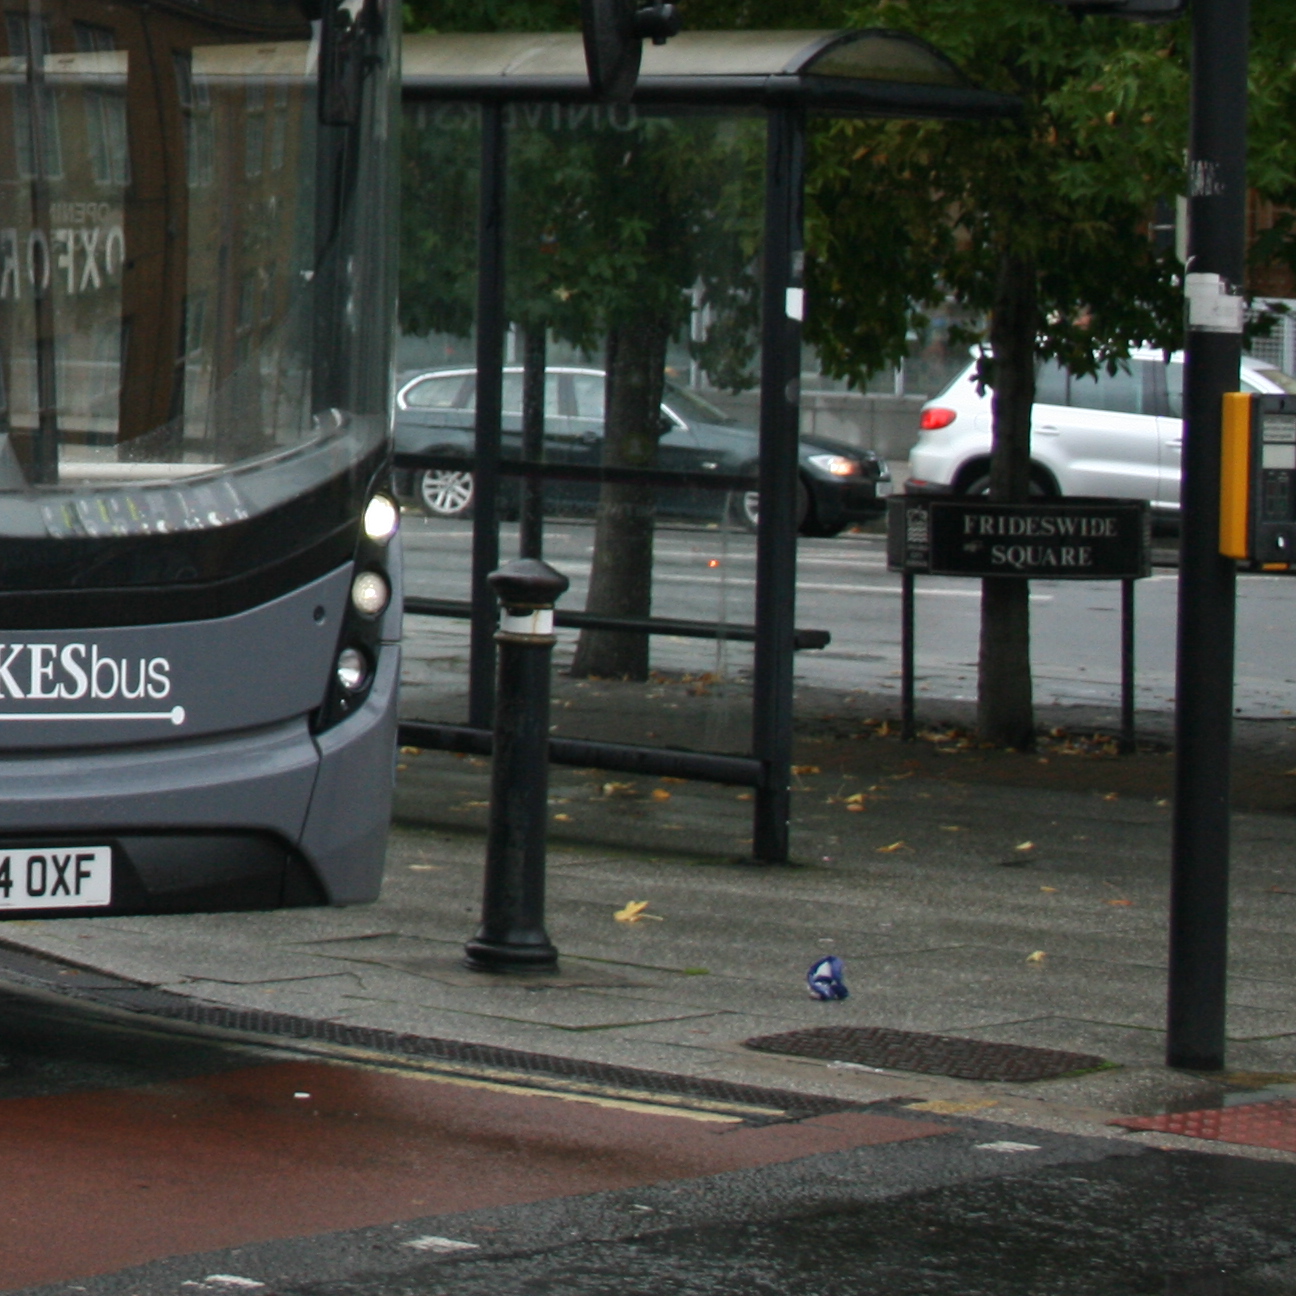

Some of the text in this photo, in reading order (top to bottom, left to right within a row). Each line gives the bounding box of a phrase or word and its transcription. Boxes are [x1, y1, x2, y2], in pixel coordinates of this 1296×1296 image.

[962, 514, 1118, 537] FRIDESWIDE
[991, 545, 1094, 570] SQUARE
[26, 853, 97, 898] OXF
